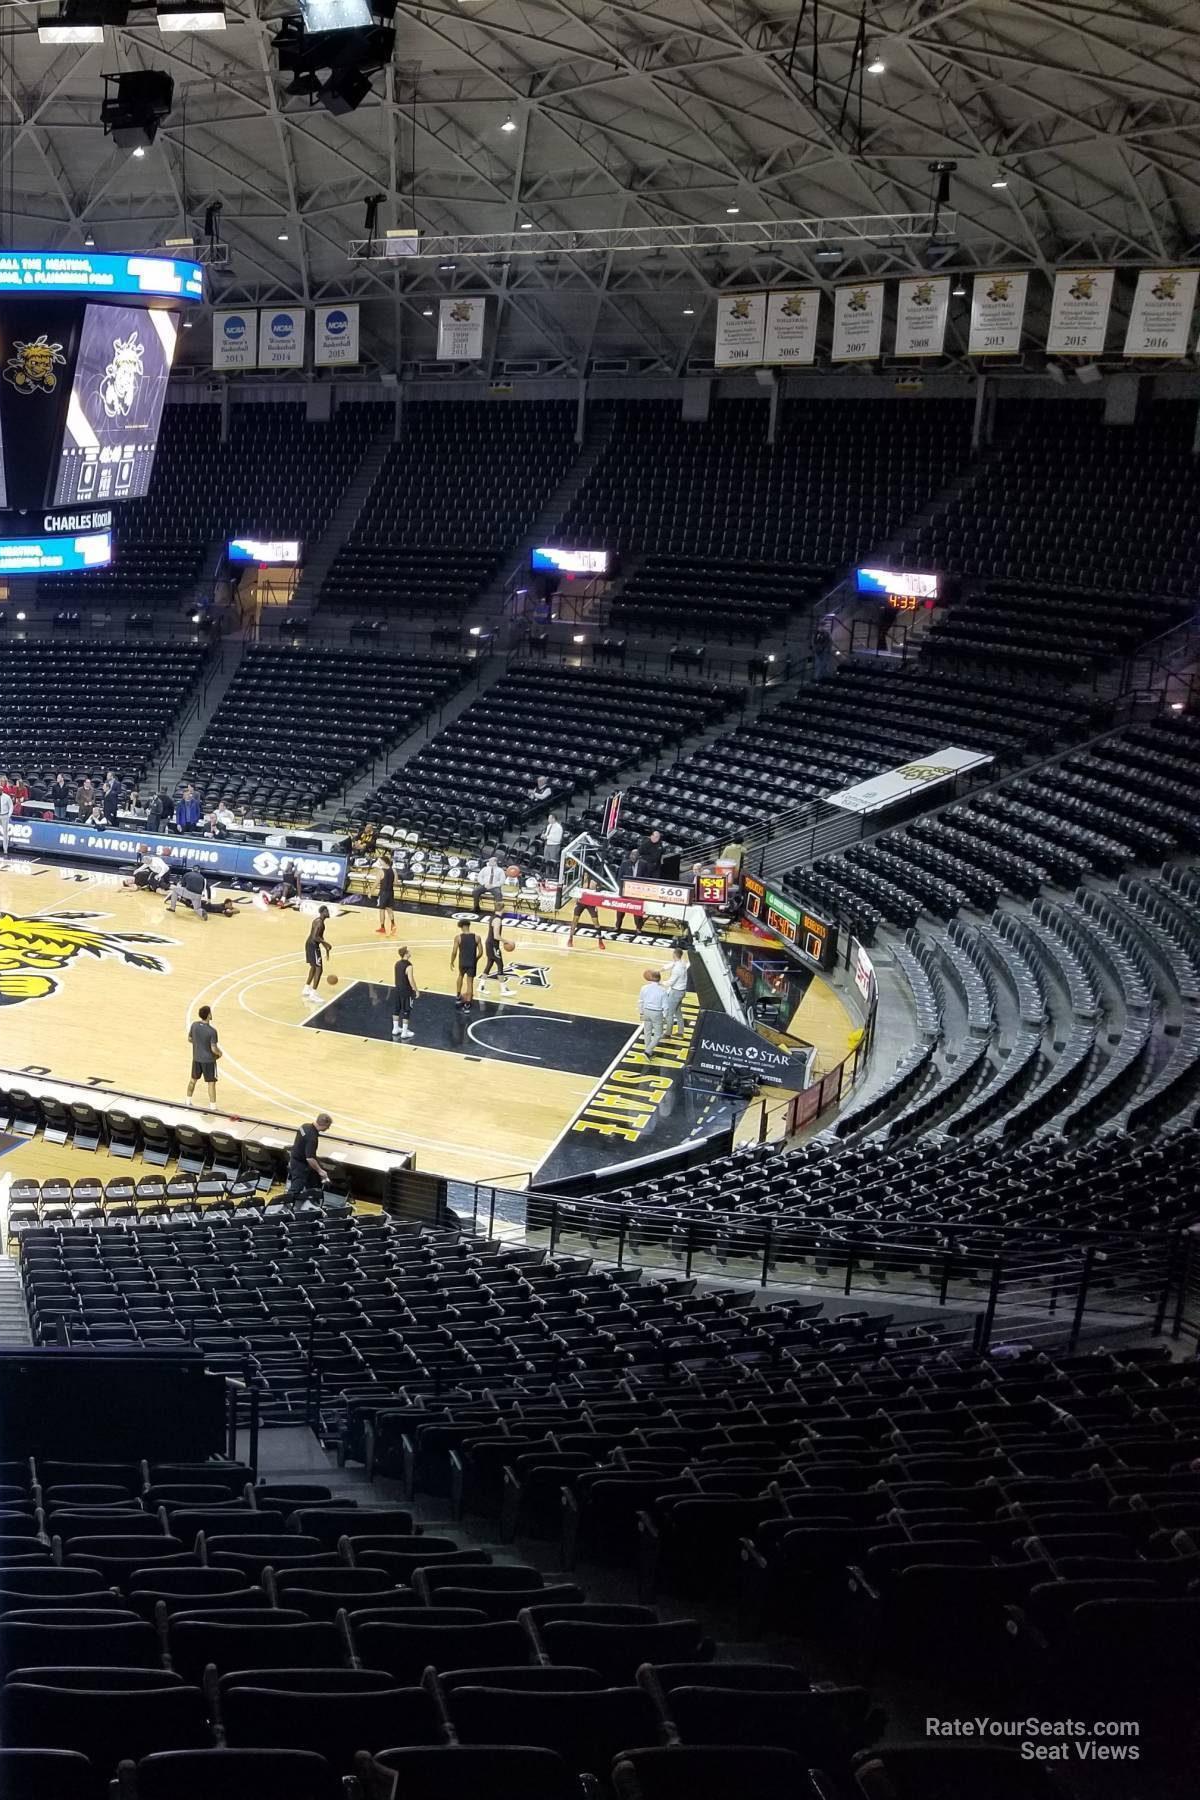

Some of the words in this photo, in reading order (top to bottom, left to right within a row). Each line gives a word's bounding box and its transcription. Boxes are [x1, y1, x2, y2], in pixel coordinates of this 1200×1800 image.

[327, 321, 348, 329] NCAA
[909, 338, 929, 349] 2008
[984, 336, 1005, 346] 2013
[1064, 336, 1087, 346] 2015
[1143, 337, 1168, 348] 2016
[778, 347, 800, 357] 2005
[846, 342, 866, 353] 2007
[728, 349, 749, 359] 2004
[43, 513, 91, 531] CHARLES
[890, 594, 916, 609] 4:33
[59, 833, 75, 845] HR
[700, 877, 724, 888] 45:40
[660, 888, 683, 897] $60
[703, 888, 720, 900] 23
[701, 1039, 744, 1056] KANSAS
[760, 1051, 790, 1067] STAR
[571, 1069, 674, 1143] STATE
